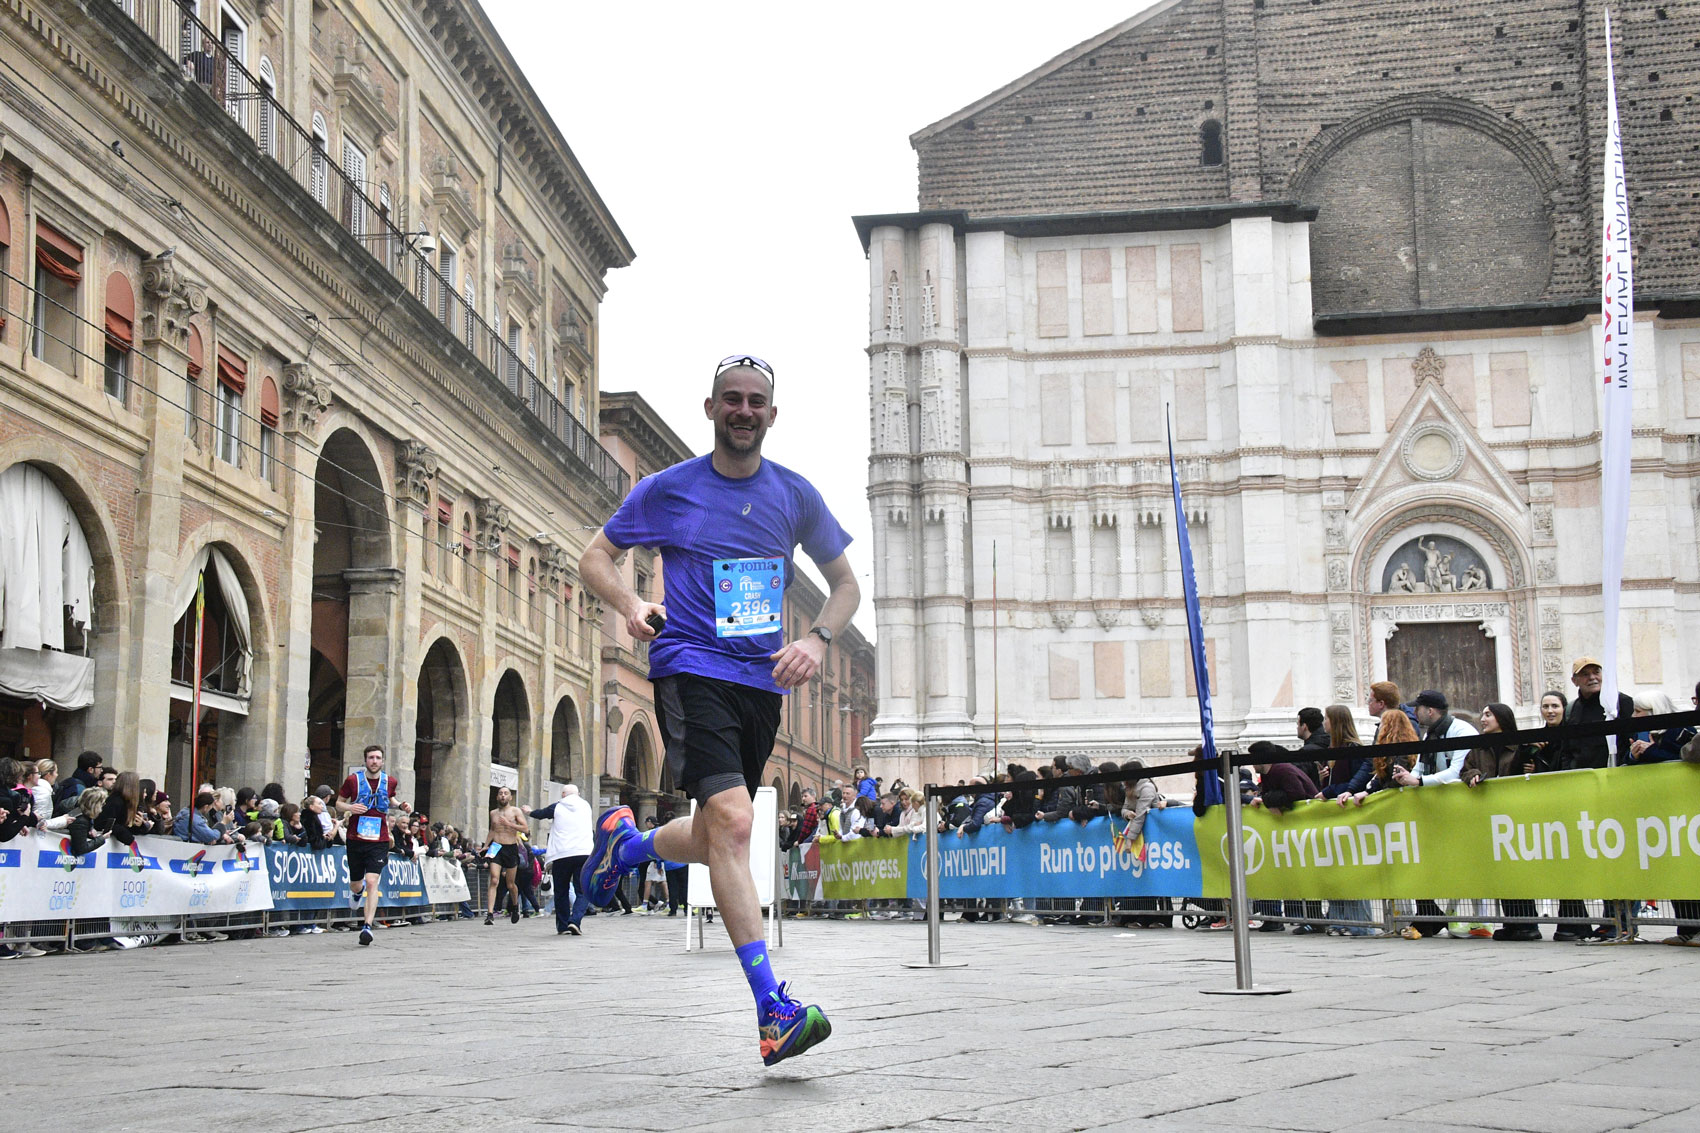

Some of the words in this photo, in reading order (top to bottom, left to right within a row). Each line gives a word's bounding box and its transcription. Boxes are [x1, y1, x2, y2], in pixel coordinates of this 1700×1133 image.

[731, 599, 770, 617] 2396
[1271, 821, 1420, 868] HYUNDAI
[1490, 814, 1570, 861] Run
[1577, 811, 1625, 859] to
[273, 851, 337, 884] SPORTLAB
[820, 859, 837, 882] Run
[837, 858, 850, 881] to
[852, 858, 901, 885] progress.
[945, 846, 1006, 877] HYUNDAI
[1040, 843, 1072, 873] Run
[1076, 842, 1096, 873] to
[53, 881, 75, 894] FOOT
[123, 881, 146, 893] FOOT
